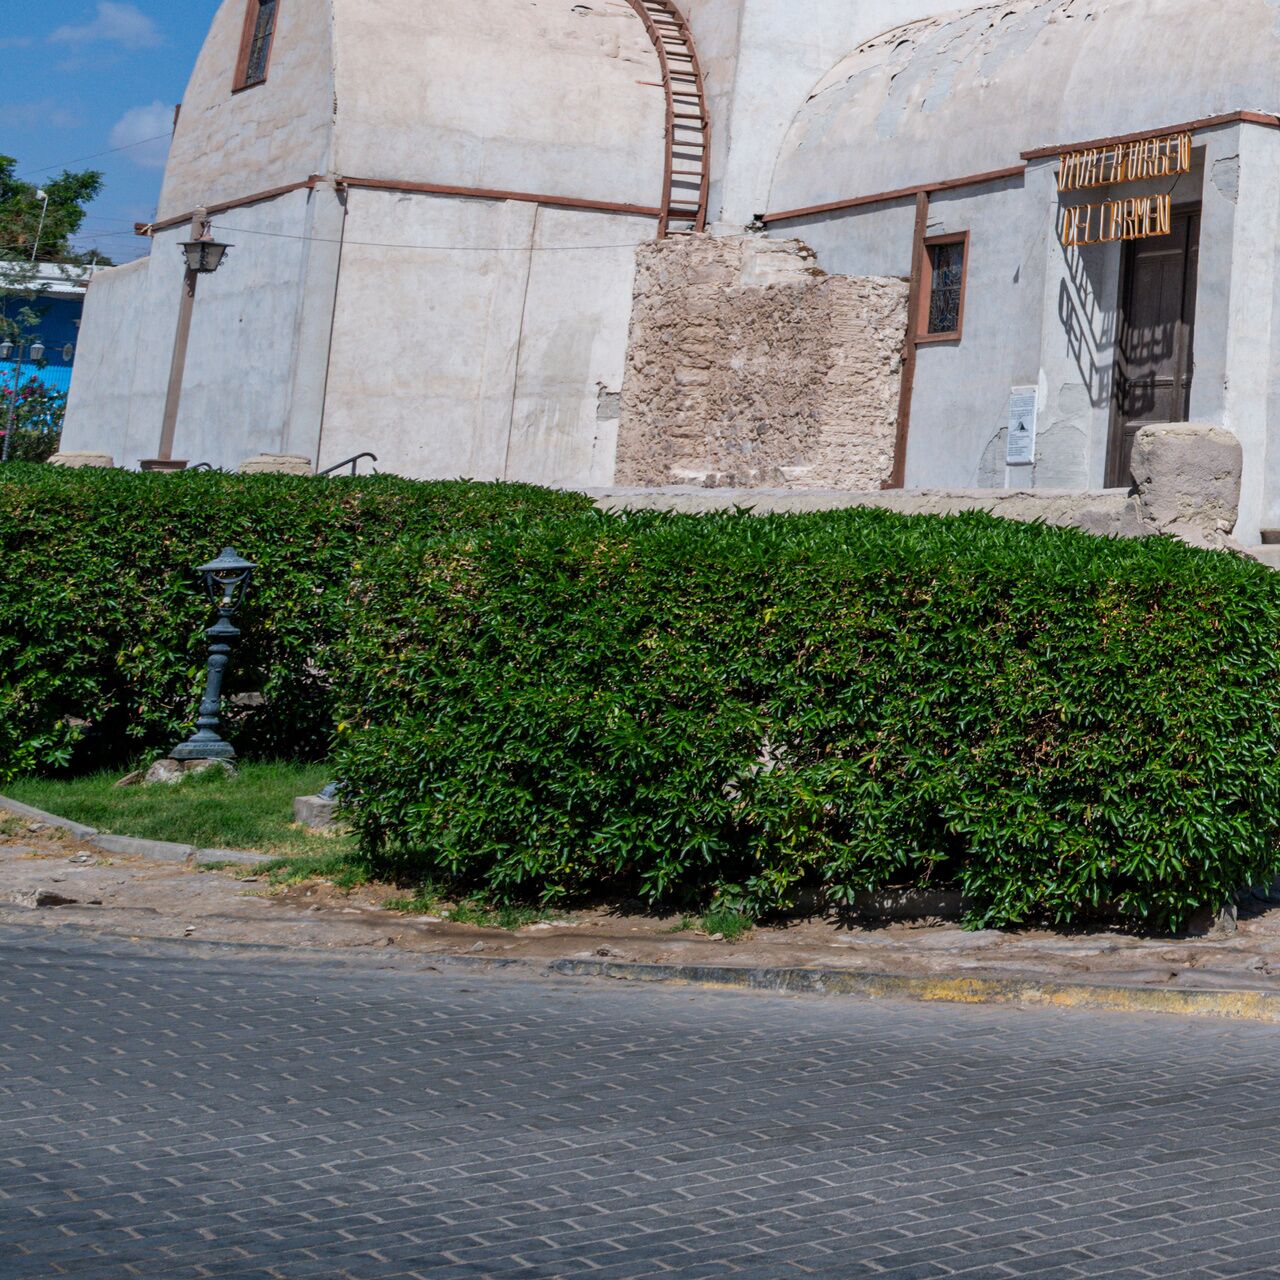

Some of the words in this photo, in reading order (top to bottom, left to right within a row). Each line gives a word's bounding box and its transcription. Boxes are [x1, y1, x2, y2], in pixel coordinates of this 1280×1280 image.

[1058, 149, 1098, 191] VIVA
[1099, 144, 1123, 184] LA
[1127, 132, 1192, 181] VIRGEN
[1062, 204, 1099, 247] DEL
[1100, 194, 1171, 241] CARMEN
